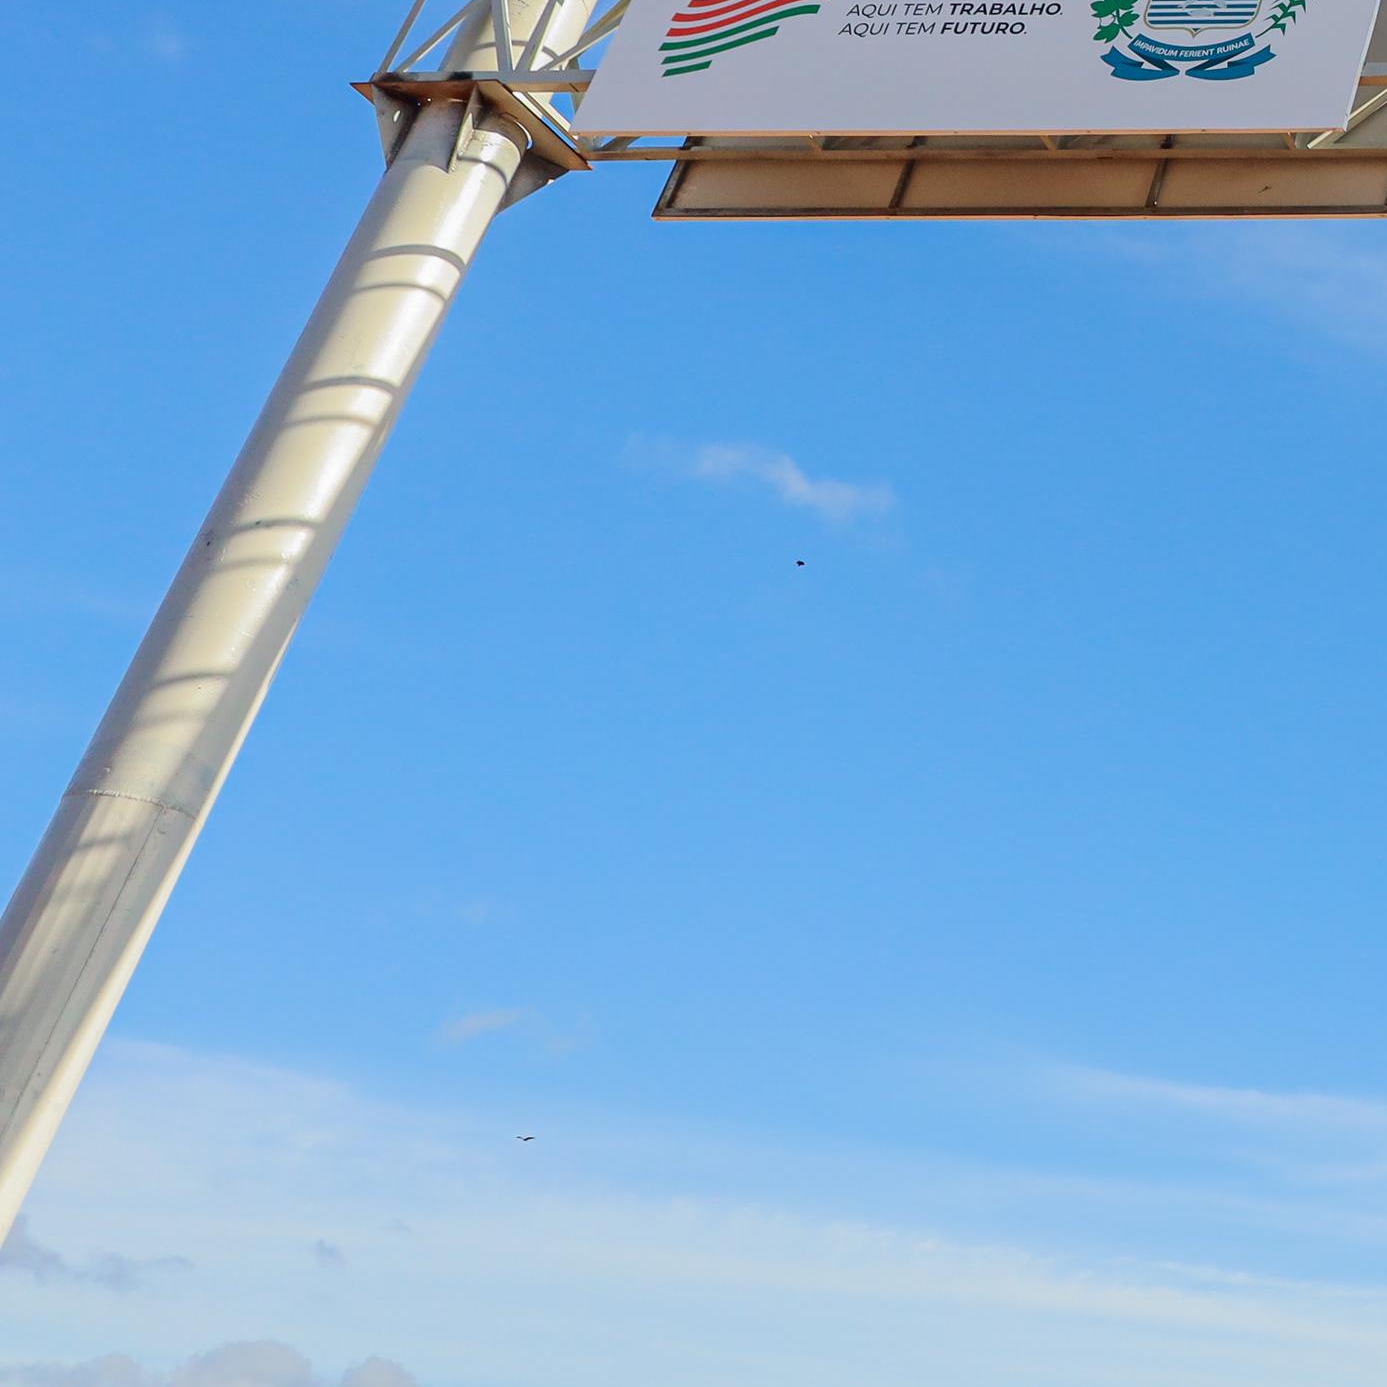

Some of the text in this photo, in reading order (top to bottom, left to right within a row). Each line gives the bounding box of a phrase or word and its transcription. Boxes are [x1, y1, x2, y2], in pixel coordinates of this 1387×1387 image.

[847, 2, 1063, 18] AQUI TEM TRABALHO.
[838, 21, 1027, 37] AQUI TEM FUTURO.
[1133, 38, 1250, 58] IMPAVIDUM FERIENT RUINAE
